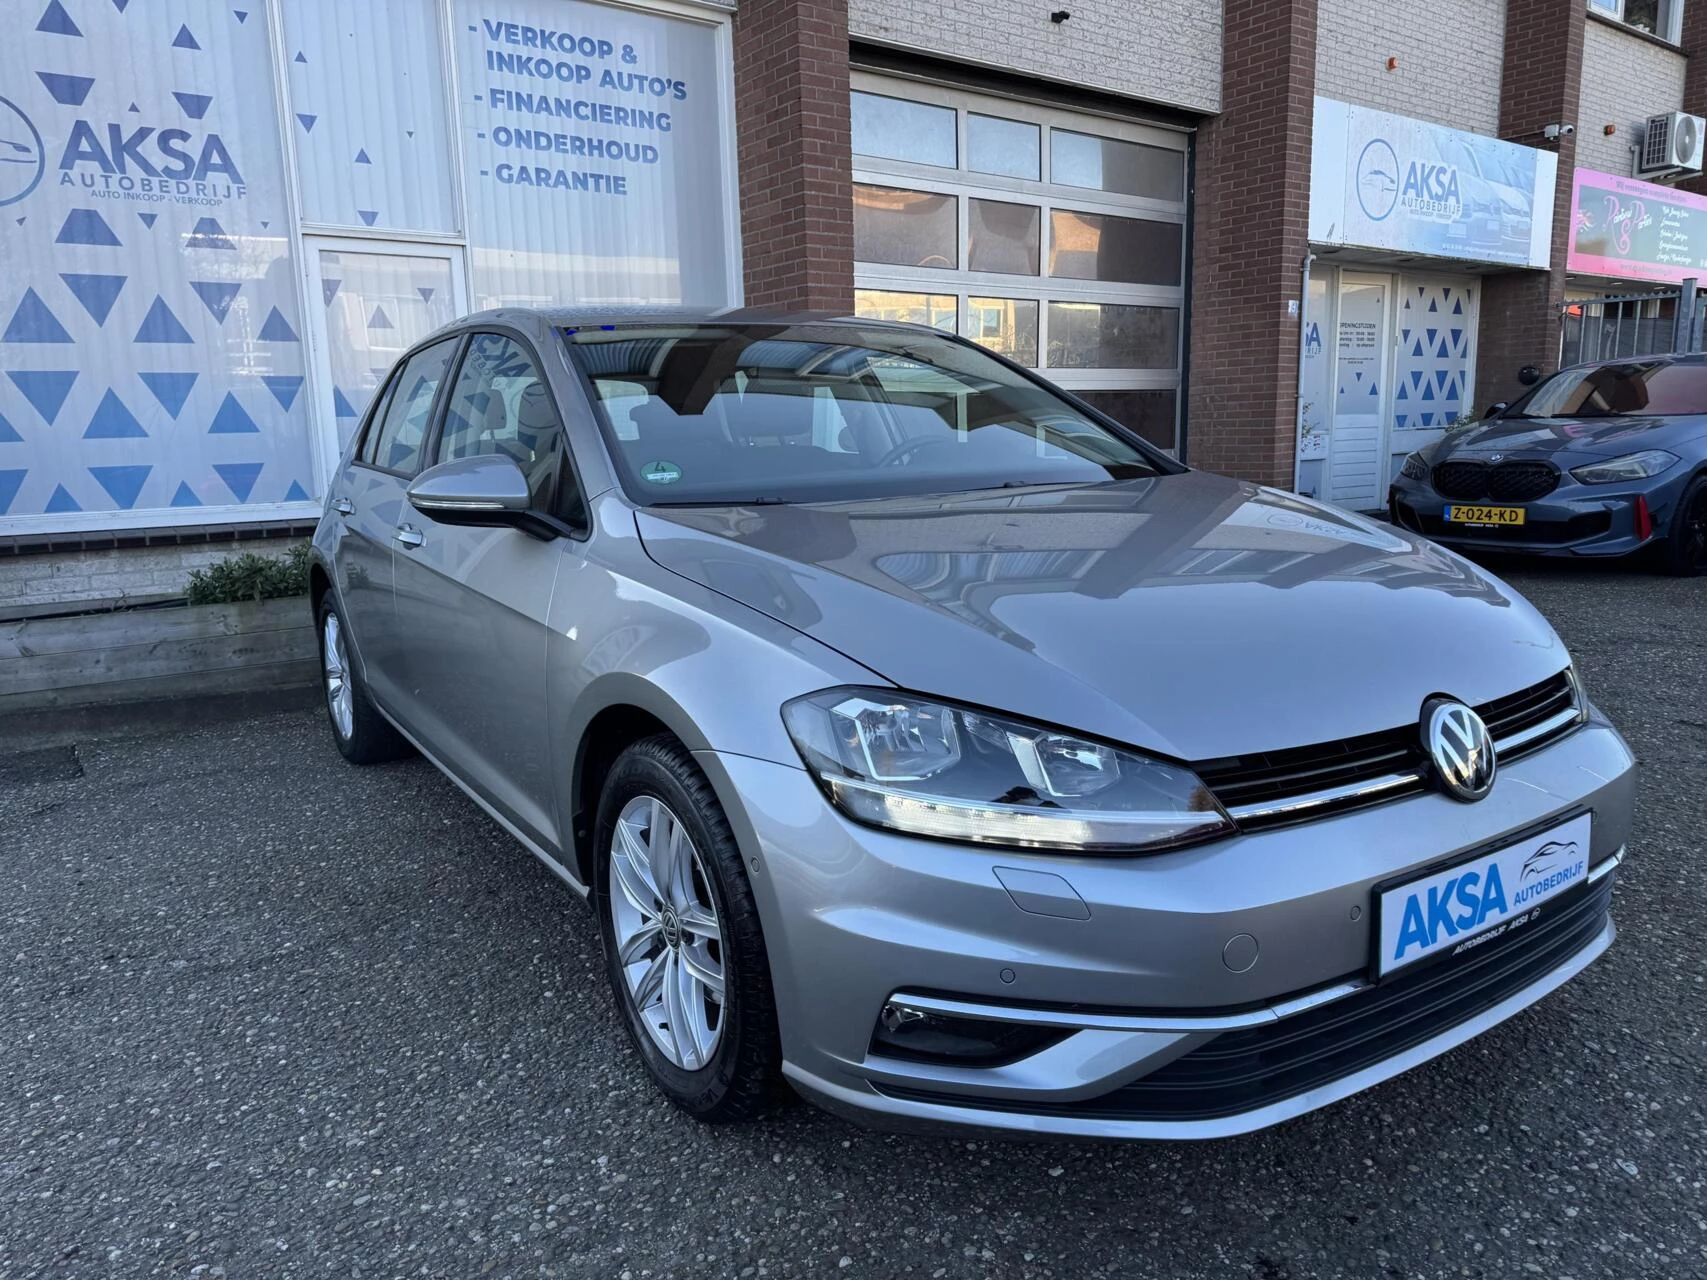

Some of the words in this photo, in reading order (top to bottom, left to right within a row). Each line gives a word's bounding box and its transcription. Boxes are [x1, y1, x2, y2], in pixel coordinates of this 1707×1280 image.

[482, 19, 613, 60] VERKOOP
[621, 44, 638, 64] &
[486, 50, 591, 84] INKOOP
[600, 69, 687, 100] AUTO'S
[489, 88, 672, 132] FINANCIERING
[58, 119, 246, 185] AKSA
[492, 126, 658, 164] ONDERHOUD
[59, 171, 247, 200] AUTOBEDRIJF
[91, 189, 120, 199] AUTO
[123, 191, 165, 202] INKOOP
[174, 195, 222, 206] VERKOOP
[495, 163, 627, 195] GARANTIE
[1402, 160, 1460, 204] AKSA
[1401, 197, 1461, 215] AUTOBEDRIJF
[1453, 507, 1519, 522] Z-024-KD
[1513, 859, 1584, 907] AUTOBEDRIJF
[1394, 862, 1509, 960] AKSA
